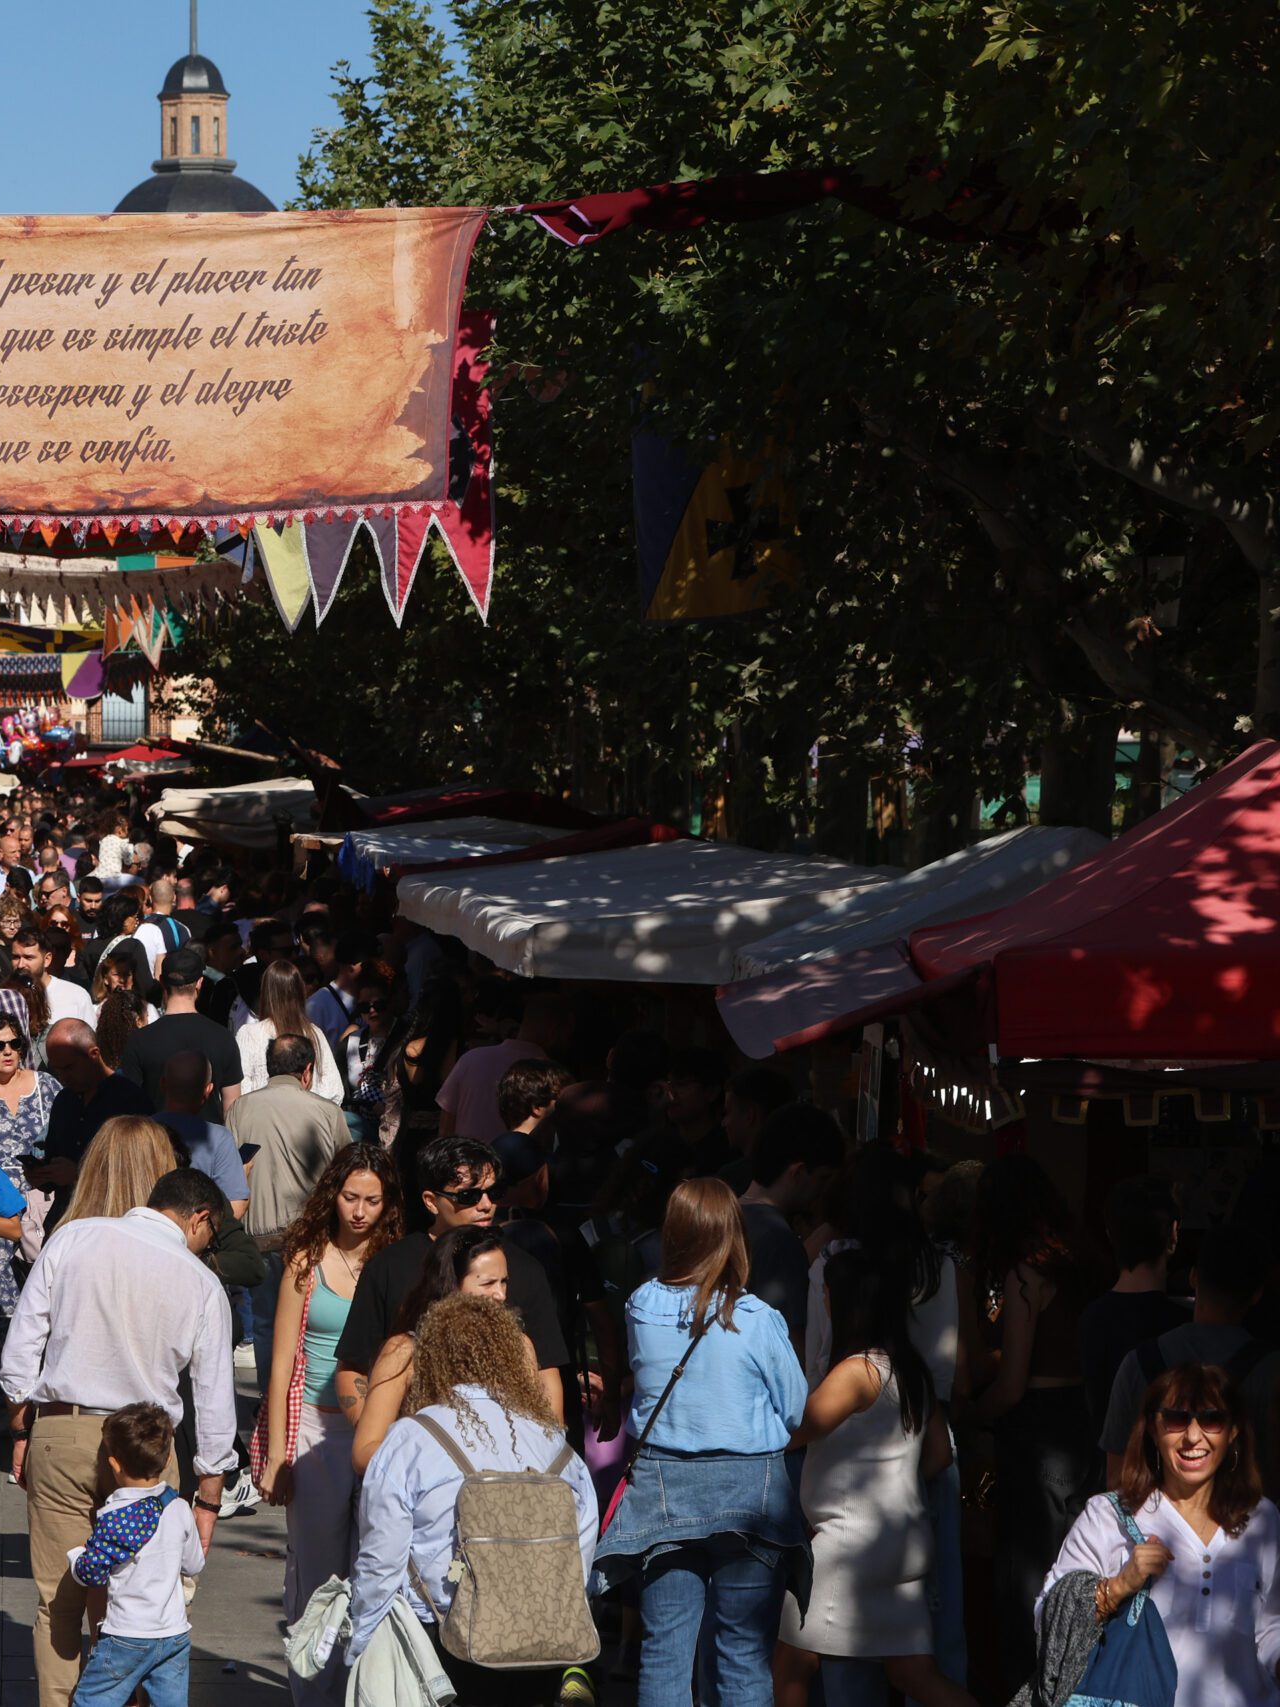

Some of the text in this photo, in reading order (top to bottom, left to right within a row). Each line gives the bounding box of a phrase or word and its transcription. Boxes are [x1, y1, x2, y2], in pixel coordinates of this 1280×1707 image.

[95, 273, 122, 310] y
[130, 258, 168, 295] el
[158, 257, 268, 307] placer
[272, 255, 323, 292] tan
[0, 328, 55, 364] que
[61, 328, 98, 352] es
[102, 313, 204, 363] simple
[209, 311, 247, 349] el
[244, 308, 329, 348] triste
[125, 384, 152, 421] y
[159, 368, 196, 406] el
[195, 367, 294, 417] alegre
[36, 440, 74, 464] se
[79, 425, 176, 475] confía.
